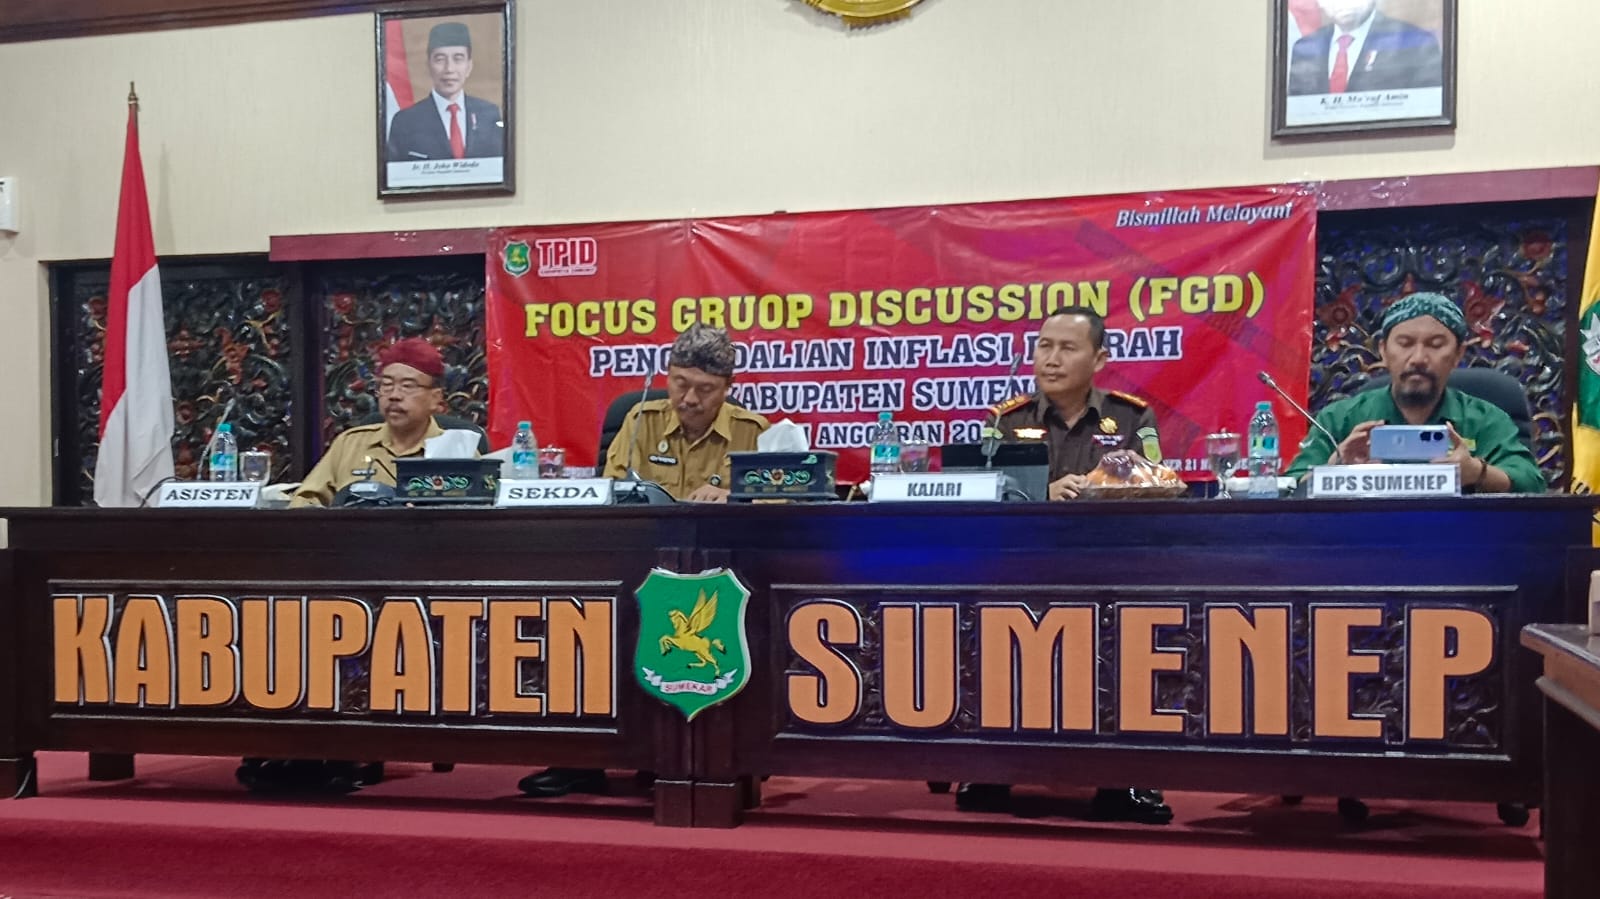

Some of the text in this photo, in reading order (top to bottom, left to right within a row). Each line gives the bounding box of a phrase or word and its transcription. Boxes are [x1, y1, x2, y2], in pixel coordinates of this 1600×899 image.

[1116, 202, 1292, 228] Bismillah Melayani
[537, 239, 597, 268] TPID
[525, 271, 1265, 337] FOCUS GRUOP DISCUSSION (FGD)
[590, 340, 854, 377] PENDALIAN
[864, 332, 1013, 370] INFLASI
[914, 376, 1036, 411] SUMEN
[816, 421, 944, 448] ANGGRAN
[951, 419, 986, 445] 20
[166, 488, 253, 501] ASISTEN
[508, 487, 600, 500] SEKDA
[907, 482, 962, 498] KAJARI
[1321, 474, 1448, 492] BPS SUMENEP
[52, 594, 1494, 739] KABUPATEN SUMENEP
